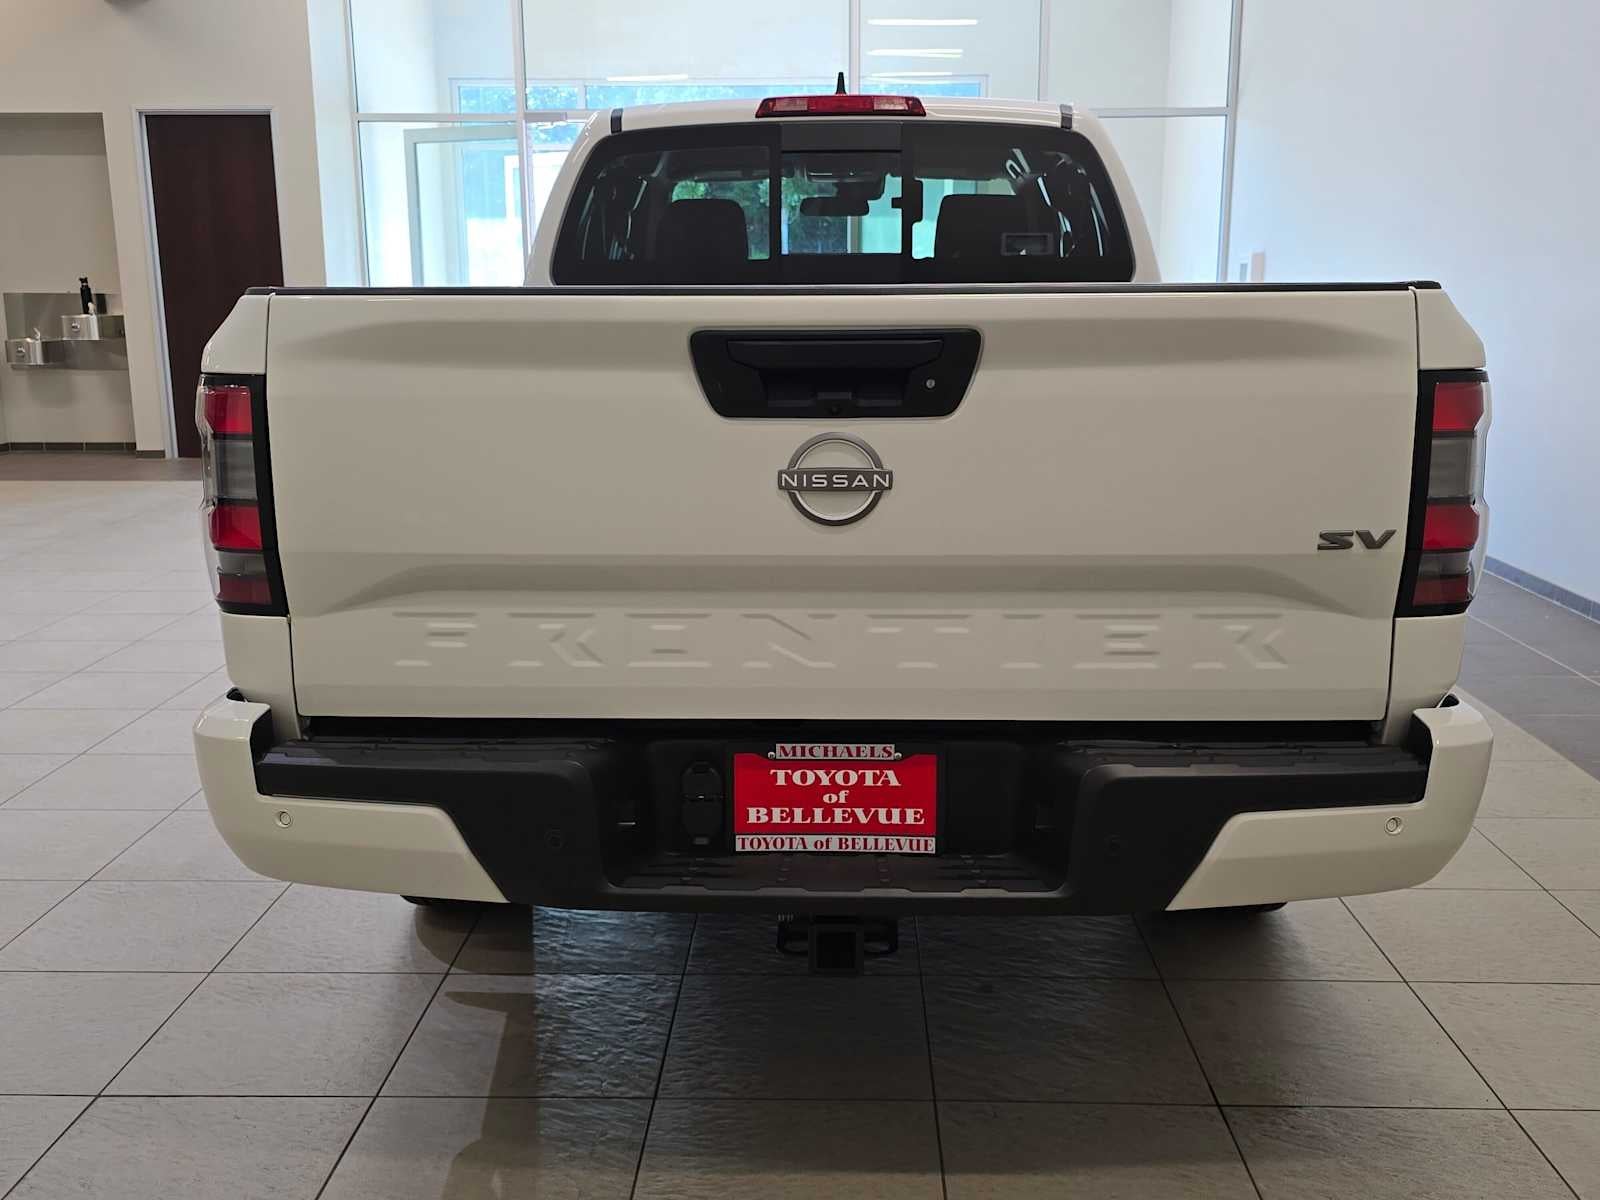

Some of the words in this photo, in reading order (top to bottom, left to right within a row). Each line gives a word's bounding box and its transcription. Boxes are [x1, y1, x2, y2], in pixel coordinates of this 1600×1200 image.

[781, 473, 890, 488] NISSAN
[1317, 529, 1397, 550] SV
[392, 611, 1289, 669] FRONTIER
[778, 744, 894, 758] MICHAELS
[769, 769, 902, 787] TOYOTA
[822, 789, 850, 804] of
[746, 807, 925, 825] BELLEVUE
[737, 836, 809, 851] TOYOTA
[813, 837, 833, 850] of
[837, 837, 935, 852] BELLEVUE
